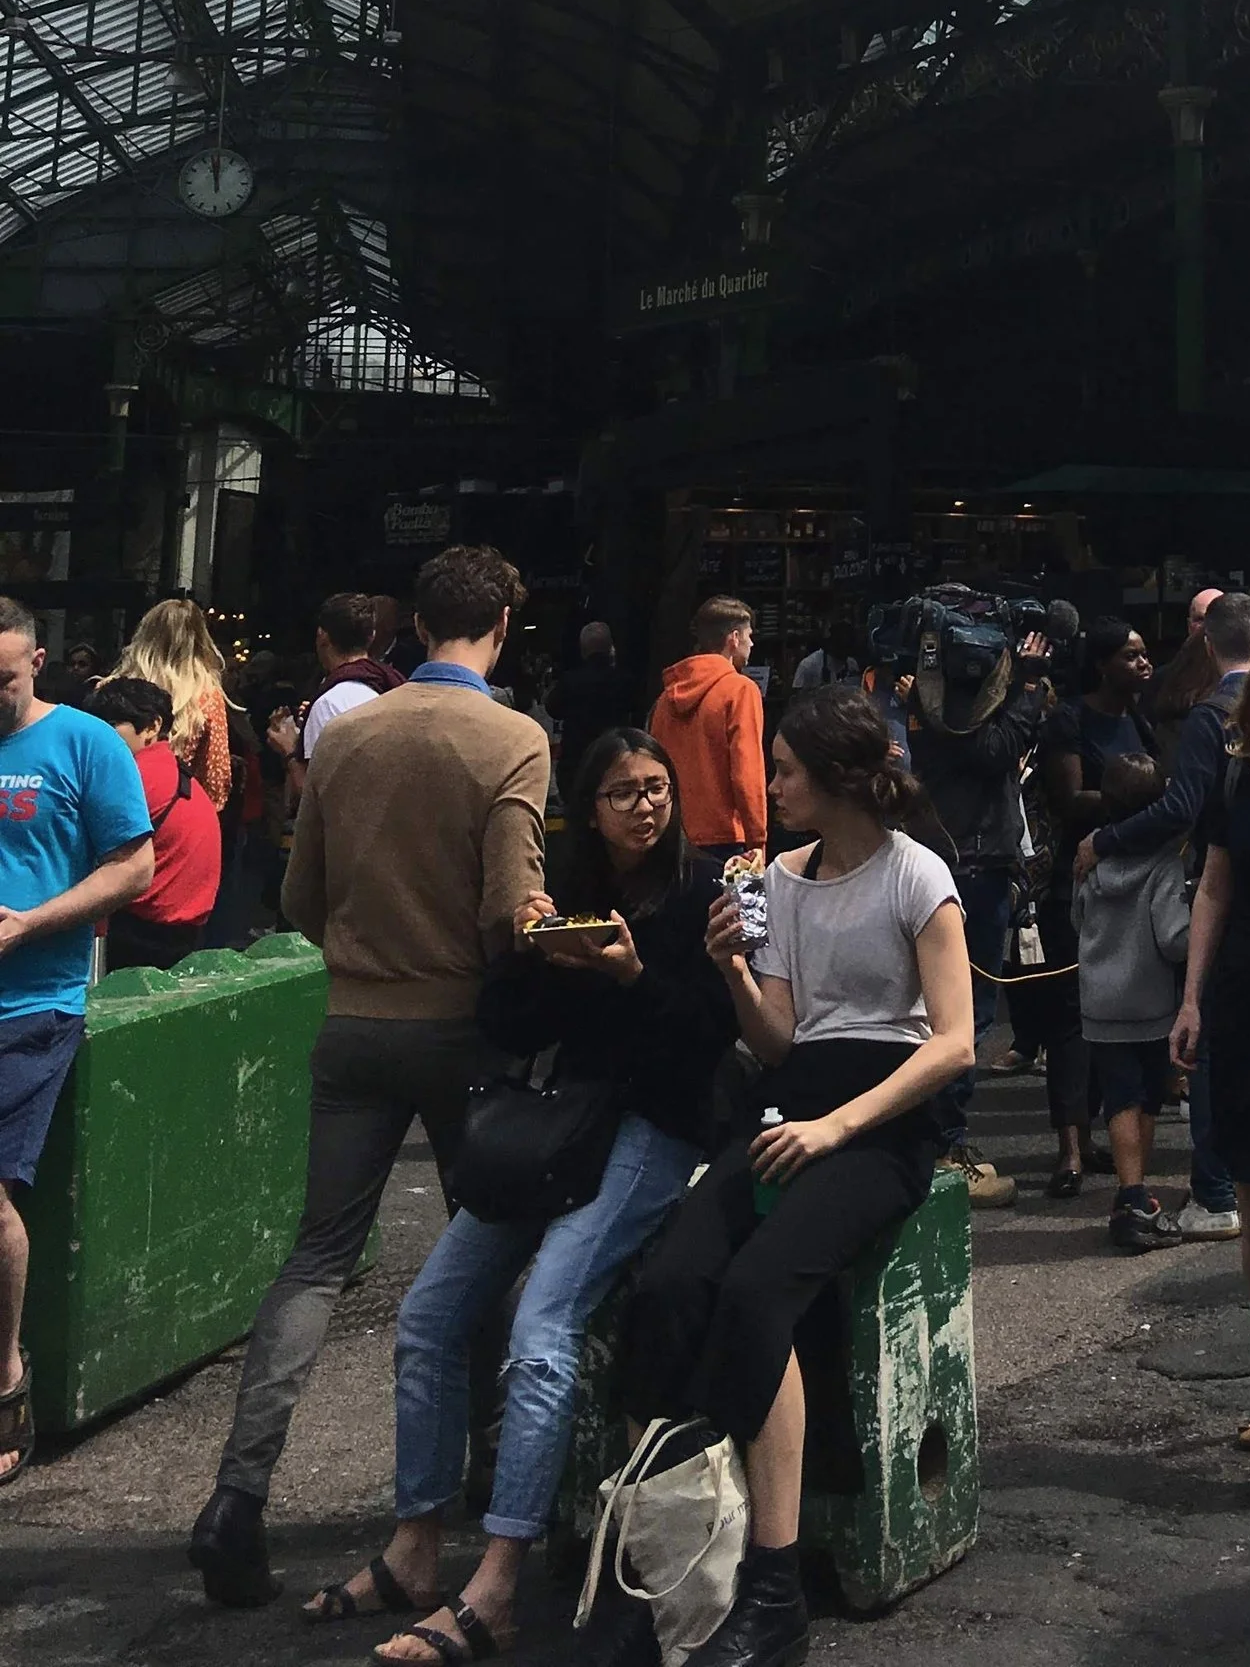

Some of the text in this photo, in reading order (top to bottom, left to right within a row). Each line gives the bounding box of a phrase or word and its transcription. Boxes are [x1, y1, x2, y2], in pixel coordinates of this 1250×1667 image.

[640, 267, 769, 311] Le Marché du Quartier
